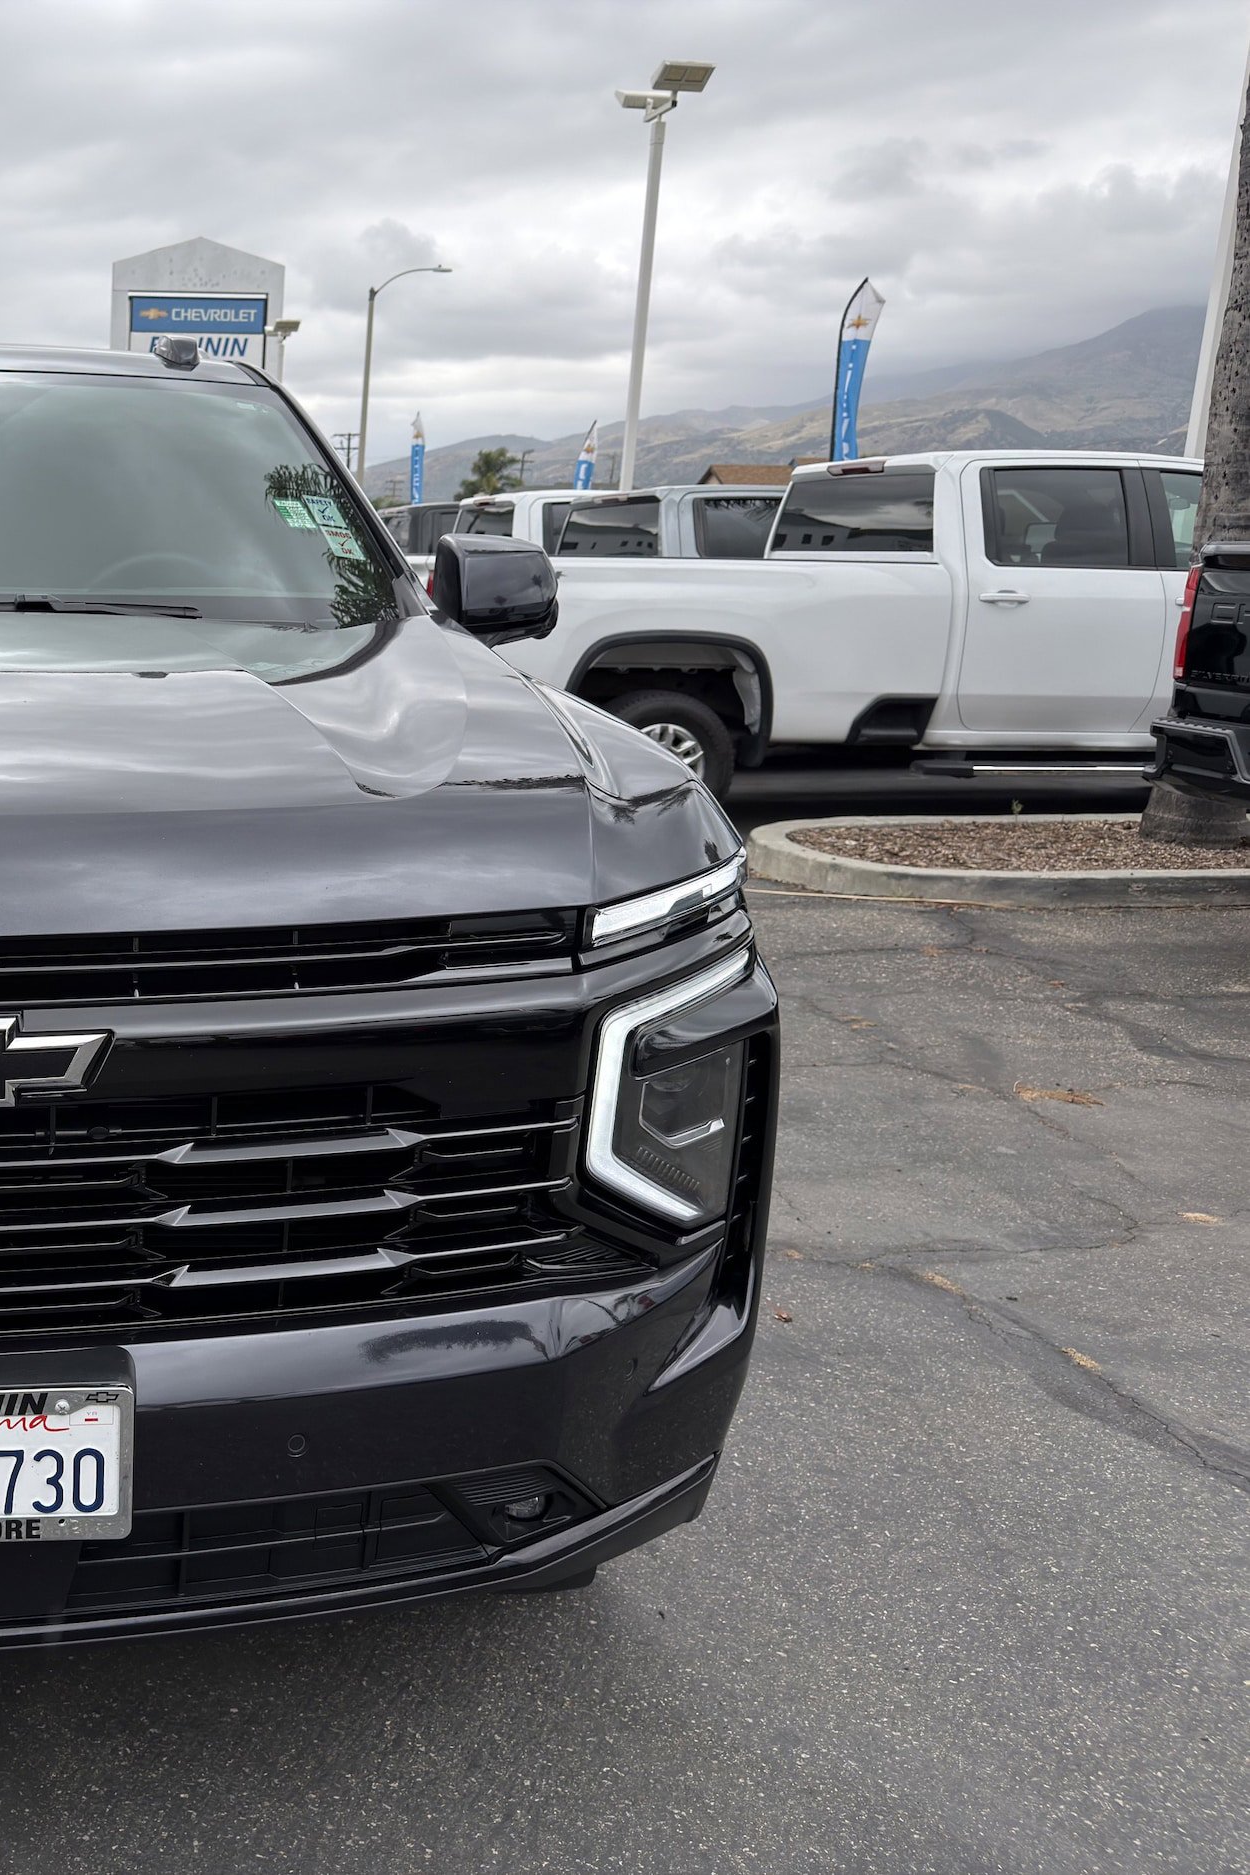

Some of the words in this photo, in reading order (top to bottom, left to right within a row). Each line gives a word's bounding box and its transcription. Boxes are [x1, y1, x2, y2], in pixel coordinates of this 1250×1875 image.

[171, 308, 257, 322] CHEVROLET
[305, 498, 332, 506] SAFETY
[322, 514, 335, 522] OK
[325, 530, 352, 539] SMOG
[341, 547, 355, 555] OK
